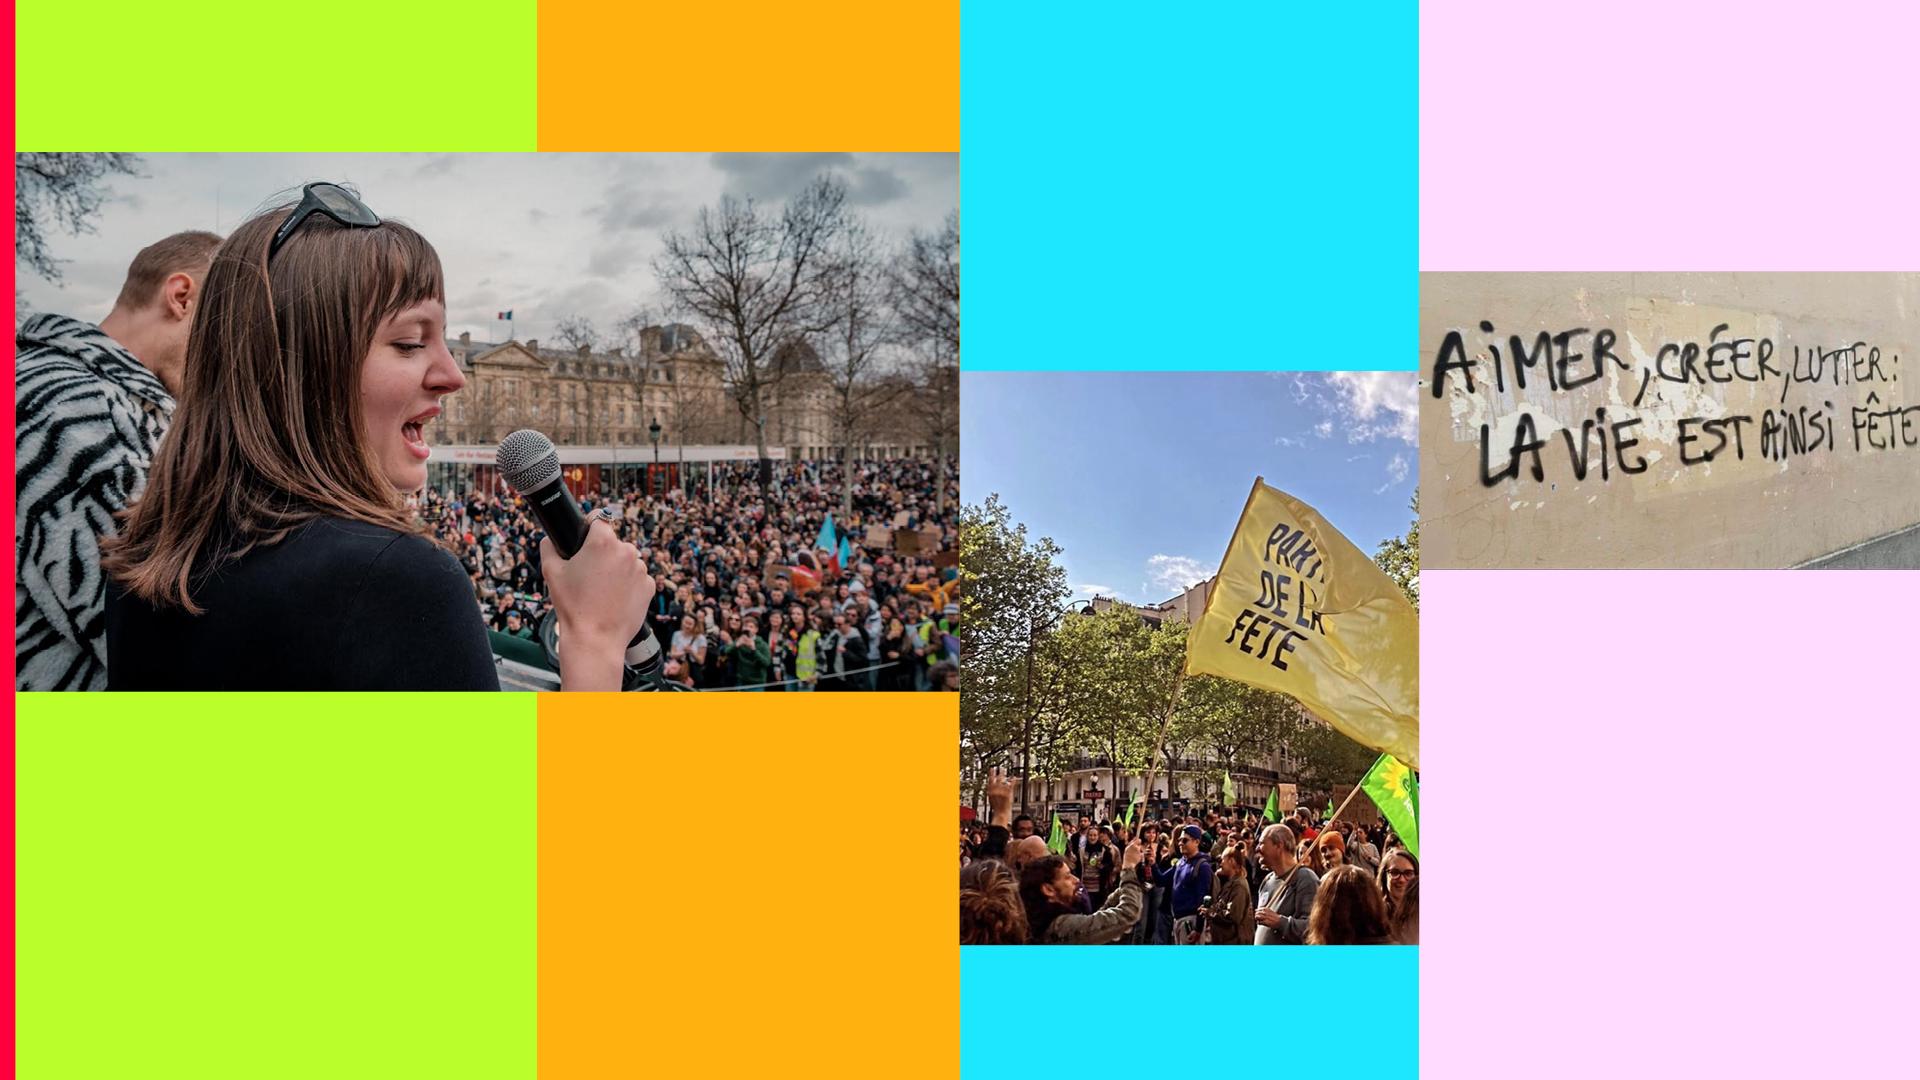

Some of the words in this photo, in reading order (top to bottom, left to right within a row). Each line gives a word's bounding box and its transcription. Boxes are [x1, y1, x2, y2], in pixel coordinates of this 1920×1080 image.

[1655, 323, 1791, 403] CRÉER,
[1480, 413, 1547, 487] LA
[1678, 415, 1754, 466] EST
[1851, 391, 1920, 452] FÊTE
[1253, 570, 1291, 618] DE
[1225, 608, 1308, 671] FETE
